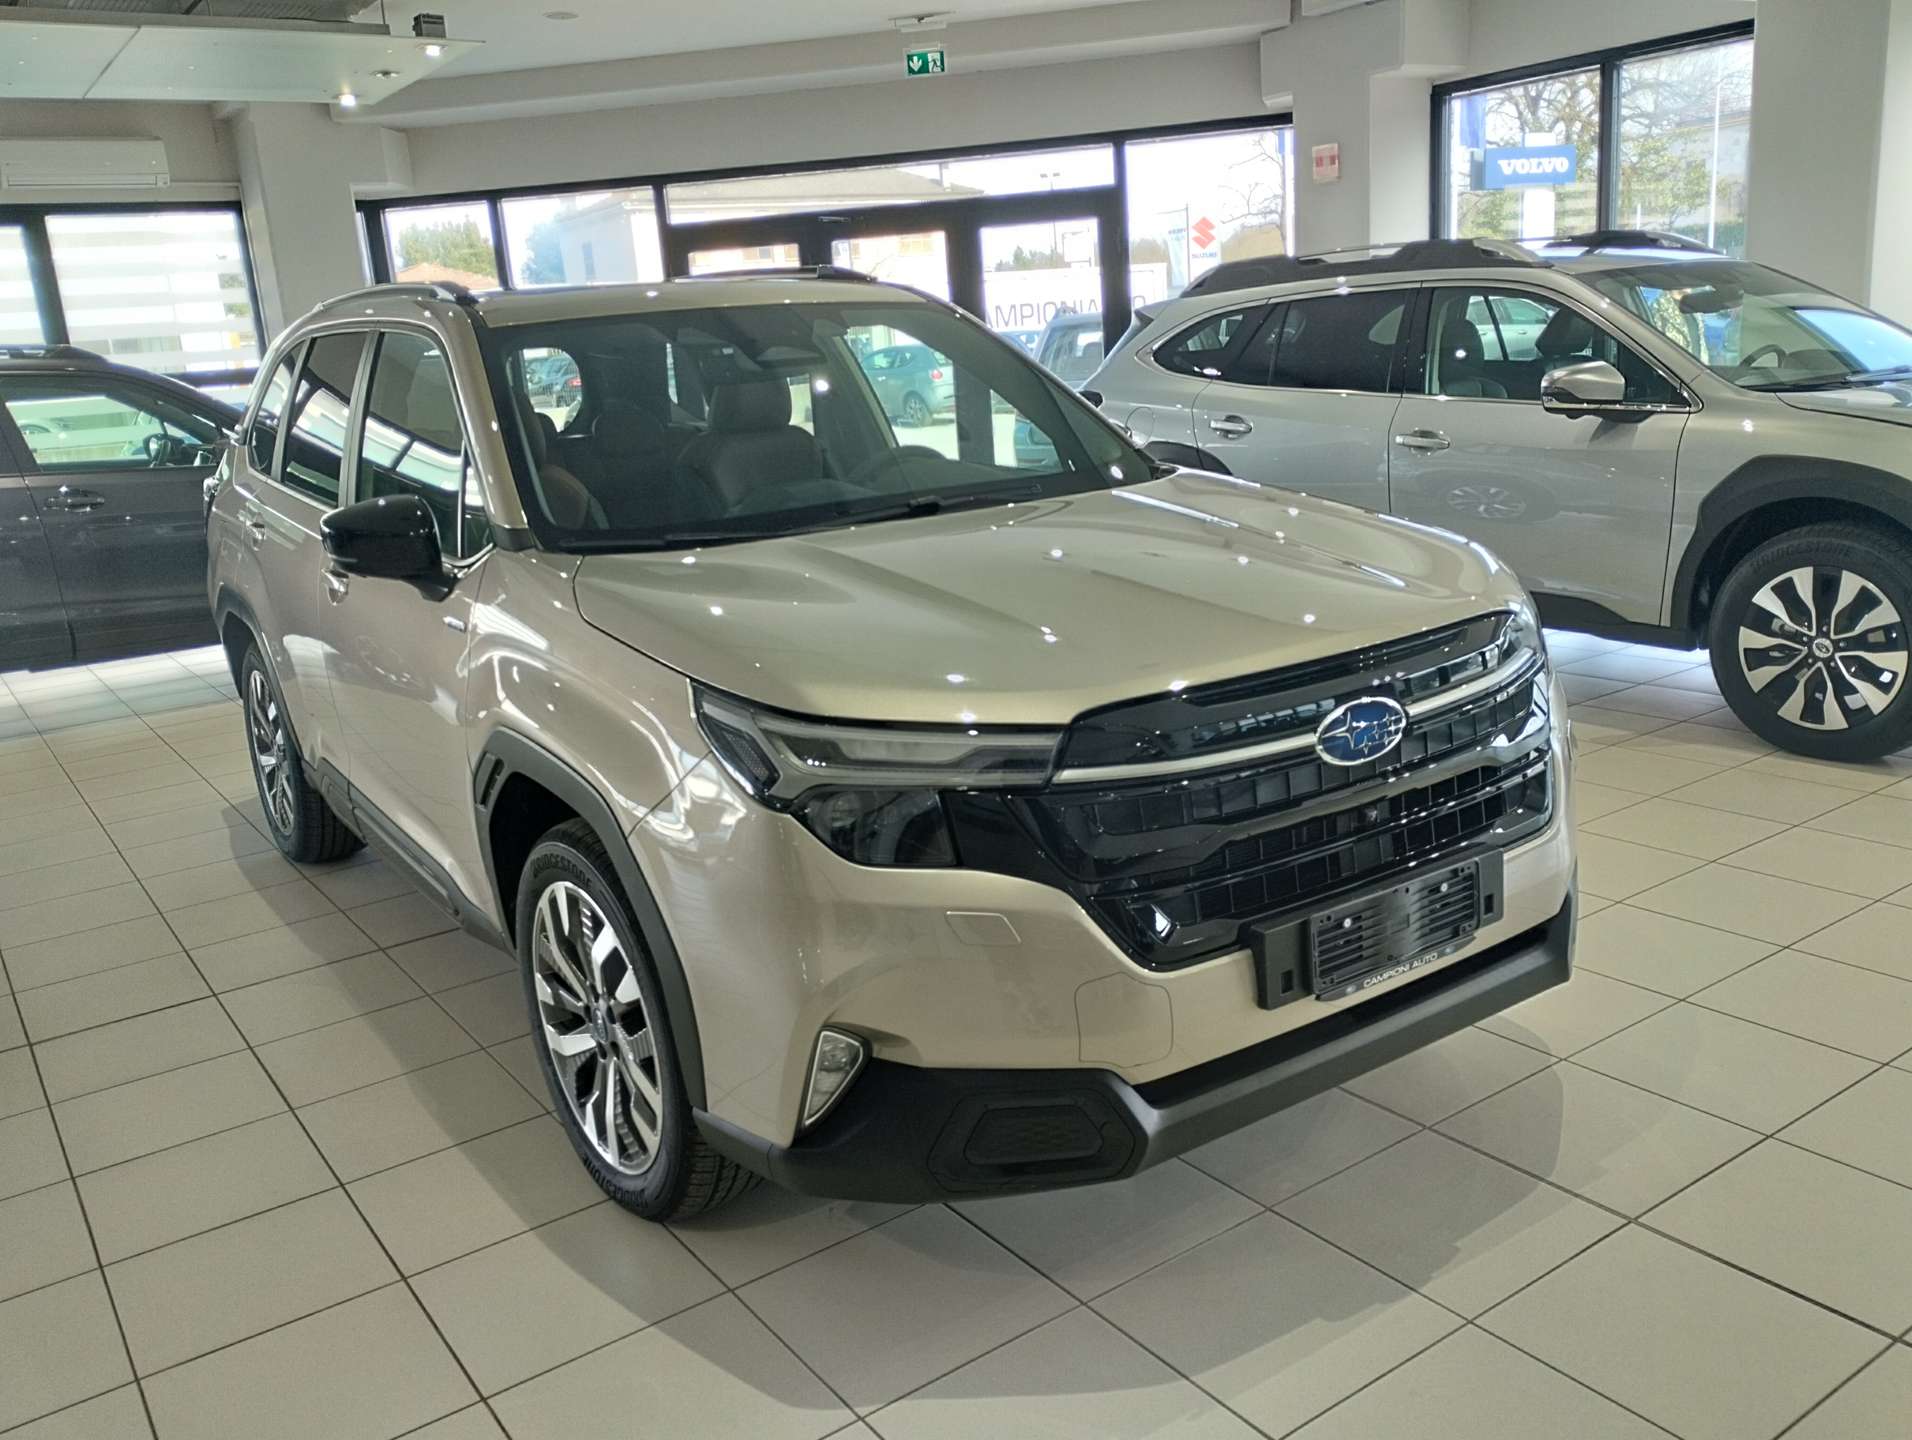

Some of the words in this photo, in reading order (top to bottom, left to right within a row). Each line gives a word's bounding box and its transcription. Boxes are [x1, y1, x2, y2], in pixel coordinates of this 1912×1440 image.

[1497, 157, 1569, 175] VOLVO
[1363, 964, 1410, 987] CAMPIONI
[1412, 952, 1438, 968] AUTO
